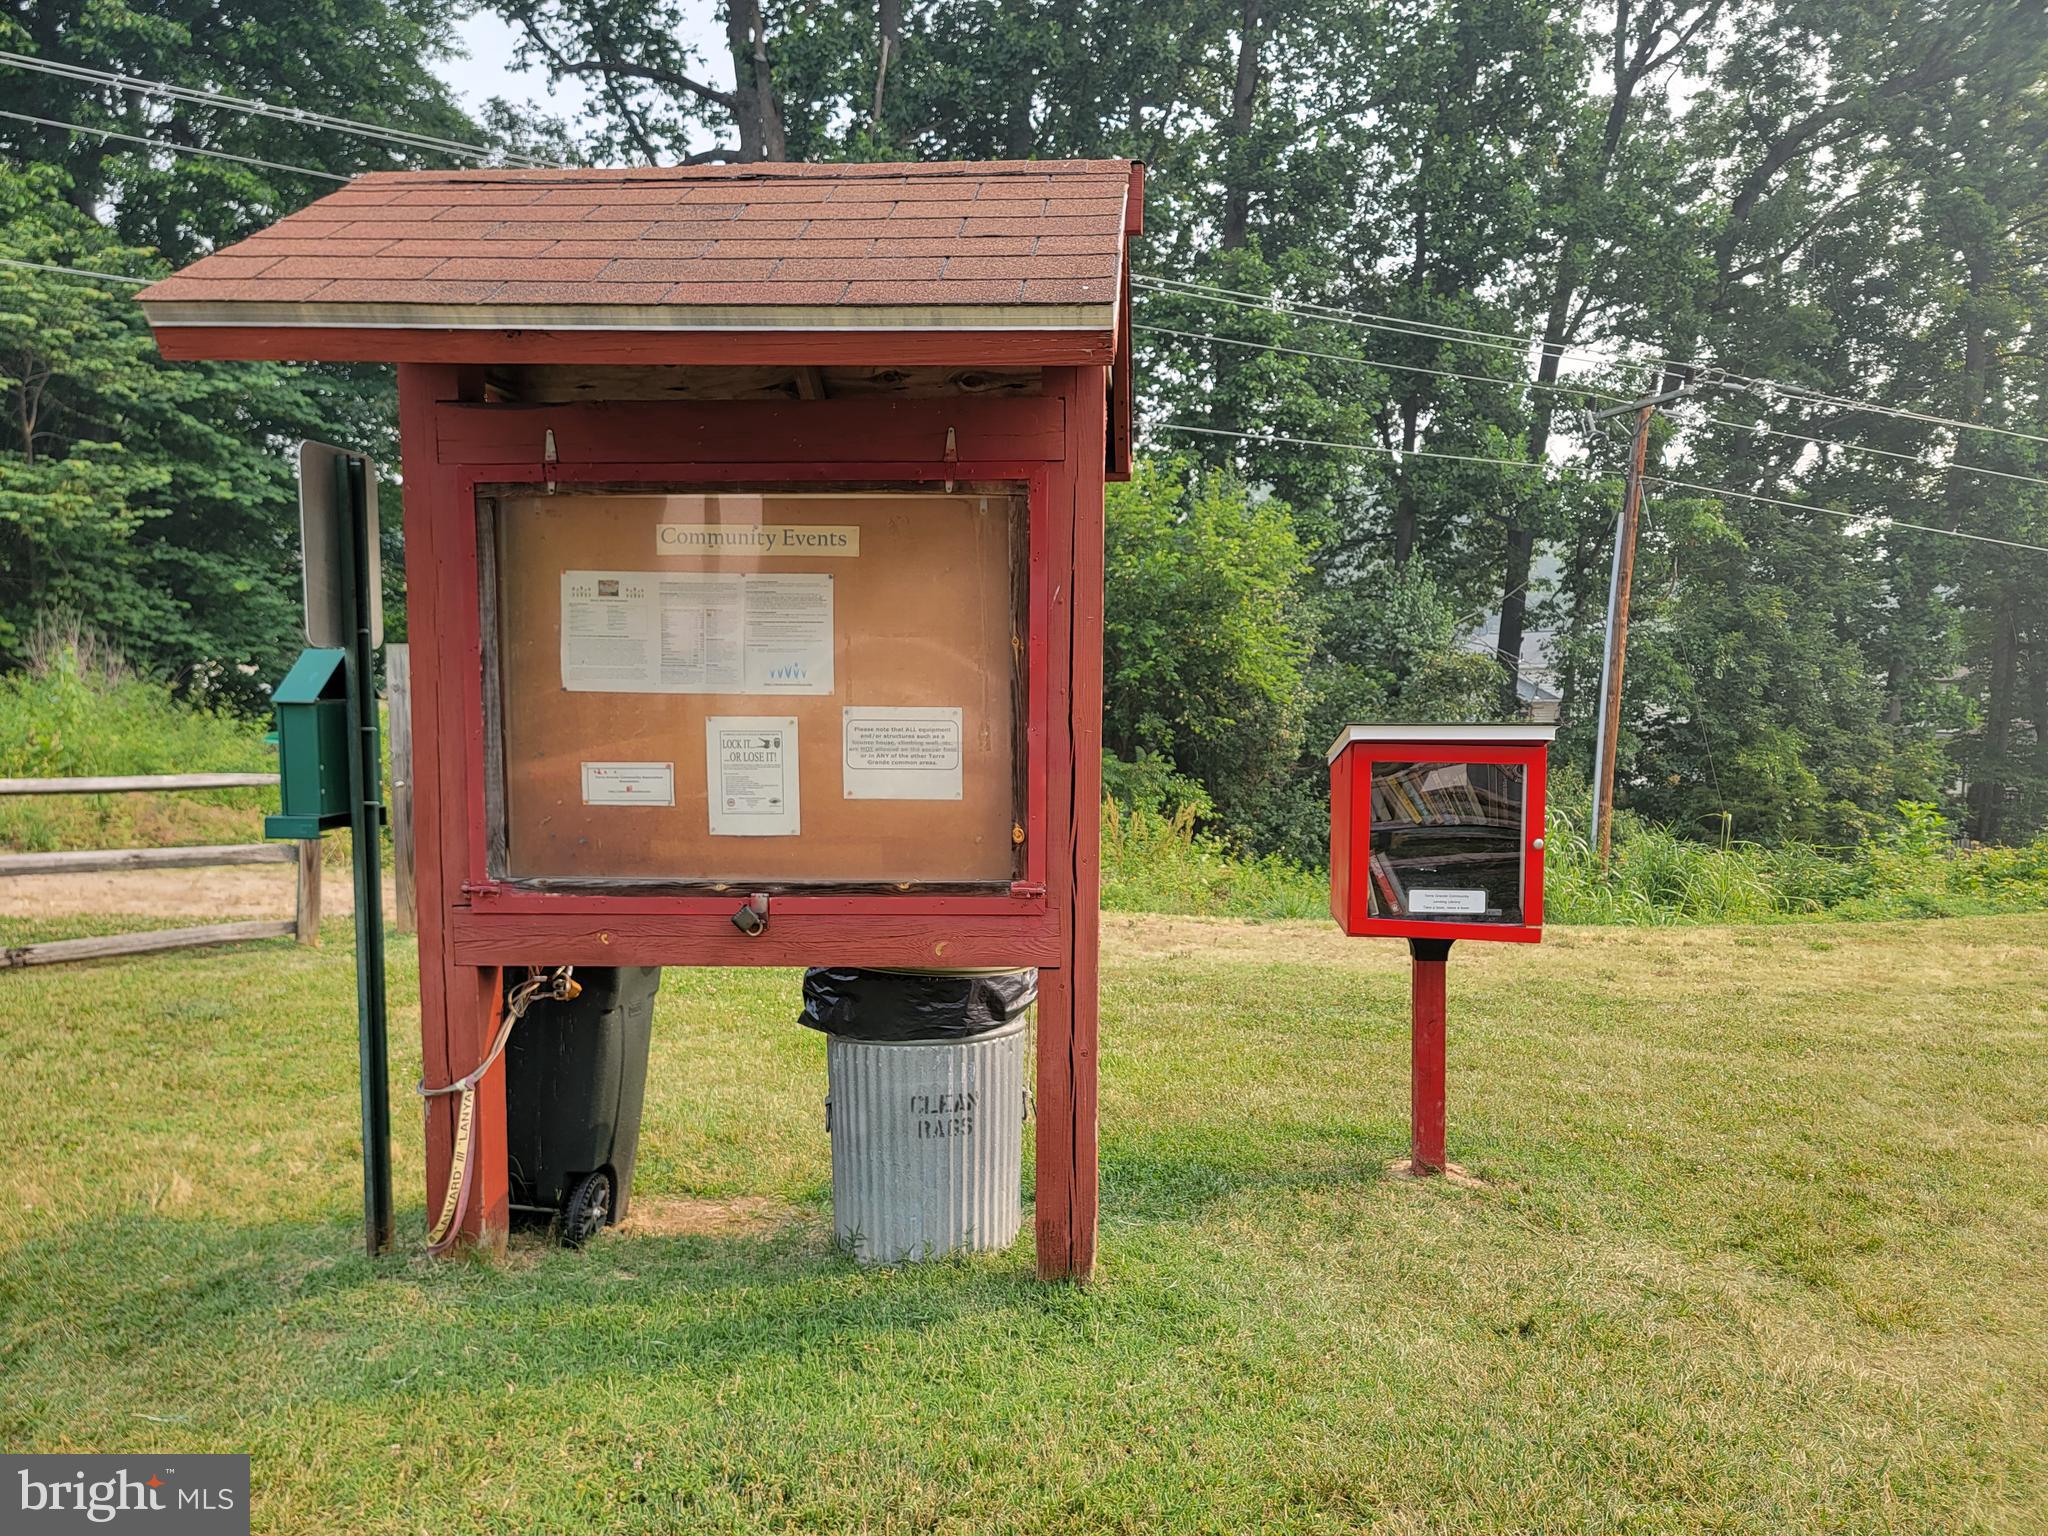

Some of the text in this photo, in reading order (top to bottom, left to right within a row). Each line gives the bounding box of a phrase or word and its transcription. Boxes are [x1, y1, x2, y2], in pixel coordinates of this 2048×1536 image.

[660, 526, 847, 551] Community Events
[722, 739, 741, 749] LOCK
[743, 752, 764, 762] LOSE
[766, 752, 777, 762] IT!
[910, 1093, 977, 1114] CLEAN
